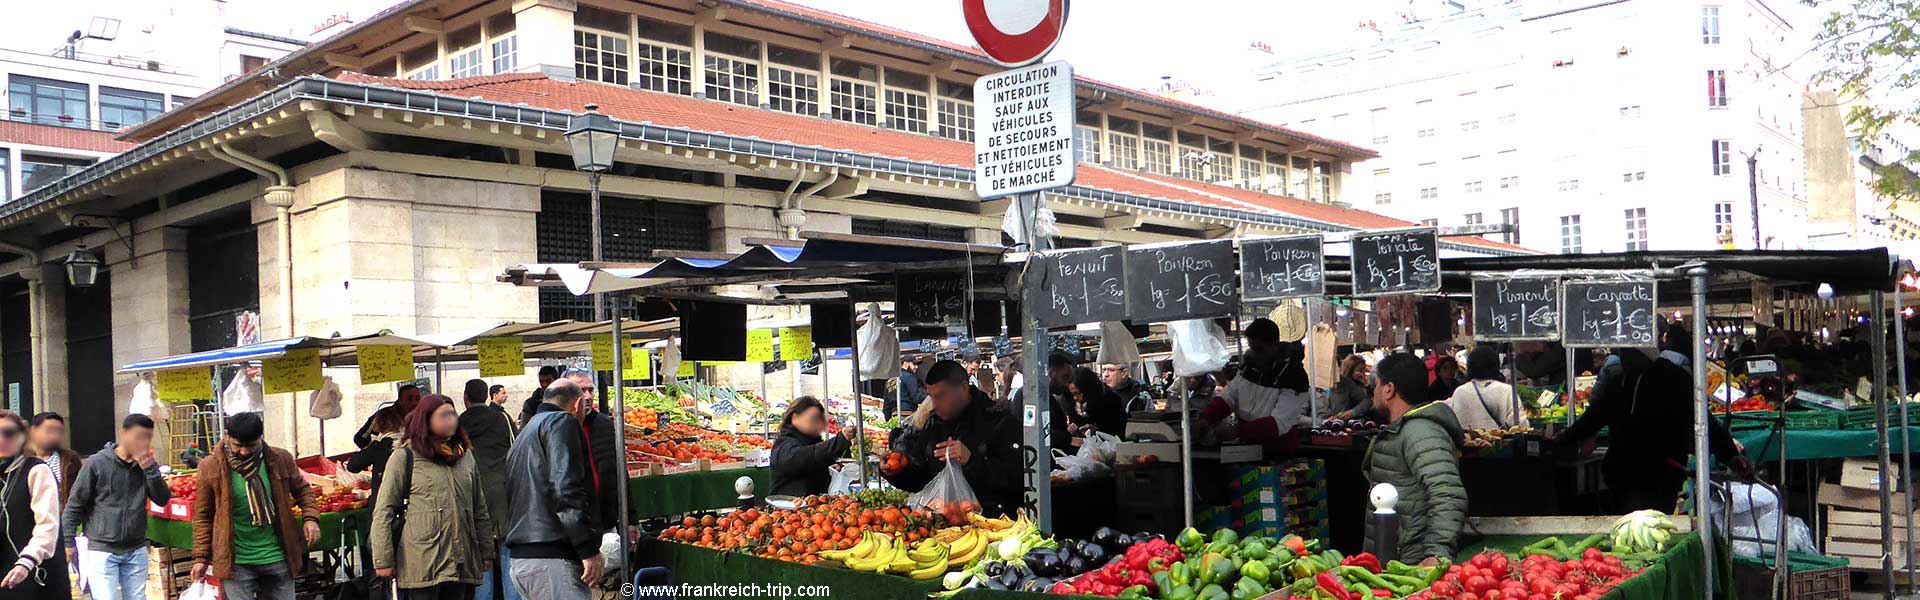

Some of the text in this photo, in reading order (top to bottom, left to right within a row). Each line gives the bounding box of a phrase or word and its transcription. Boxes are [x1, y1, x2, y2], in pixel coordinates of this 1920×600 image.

[986, 65, 1057, 91] CIRCULATION
[993, 82, 1050, 104] INTERDITE
[995, 97, 1049, 118] SAUF AUX
[992, 111, 1053, 133] VÉHICULES
[989, 125, 1057, 148] DE SECOURS
[978, 138, 1070, 164] ET NETTOIEMENT
[985, 154, 1063, 177] ET VÉHICULES
[992, 170, 1056, 190] DE MARCHÉ
